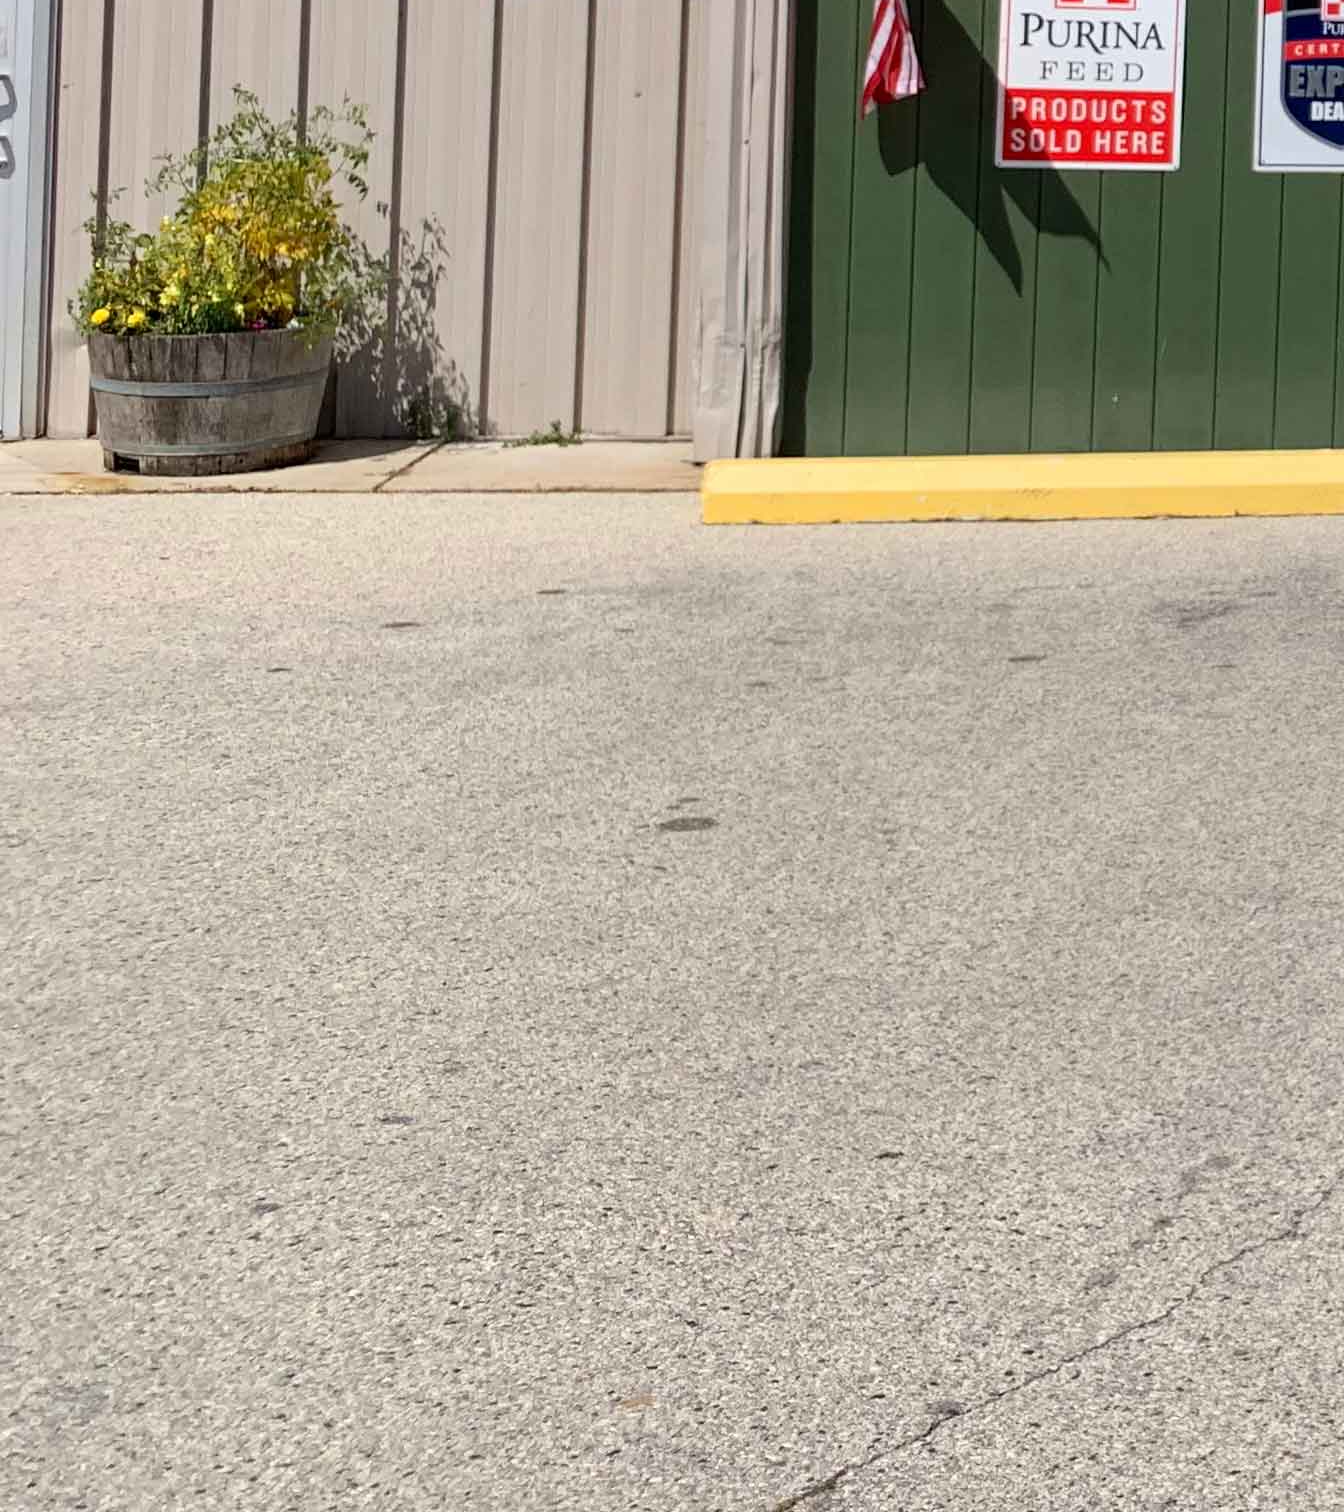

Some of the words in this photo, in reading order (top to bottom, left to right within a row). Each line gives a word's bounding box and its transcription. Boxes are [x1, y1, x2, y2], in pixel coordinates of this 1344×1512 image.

[1019, 12, 1166, 55] PURINA
[1040, 60, 1145, 82] FEED
[1010, 96, 1167, 124] PRODUCTS
[1010, 127, 1083, 153] SOLD
[1093, 129, 1166, 156] HERE
